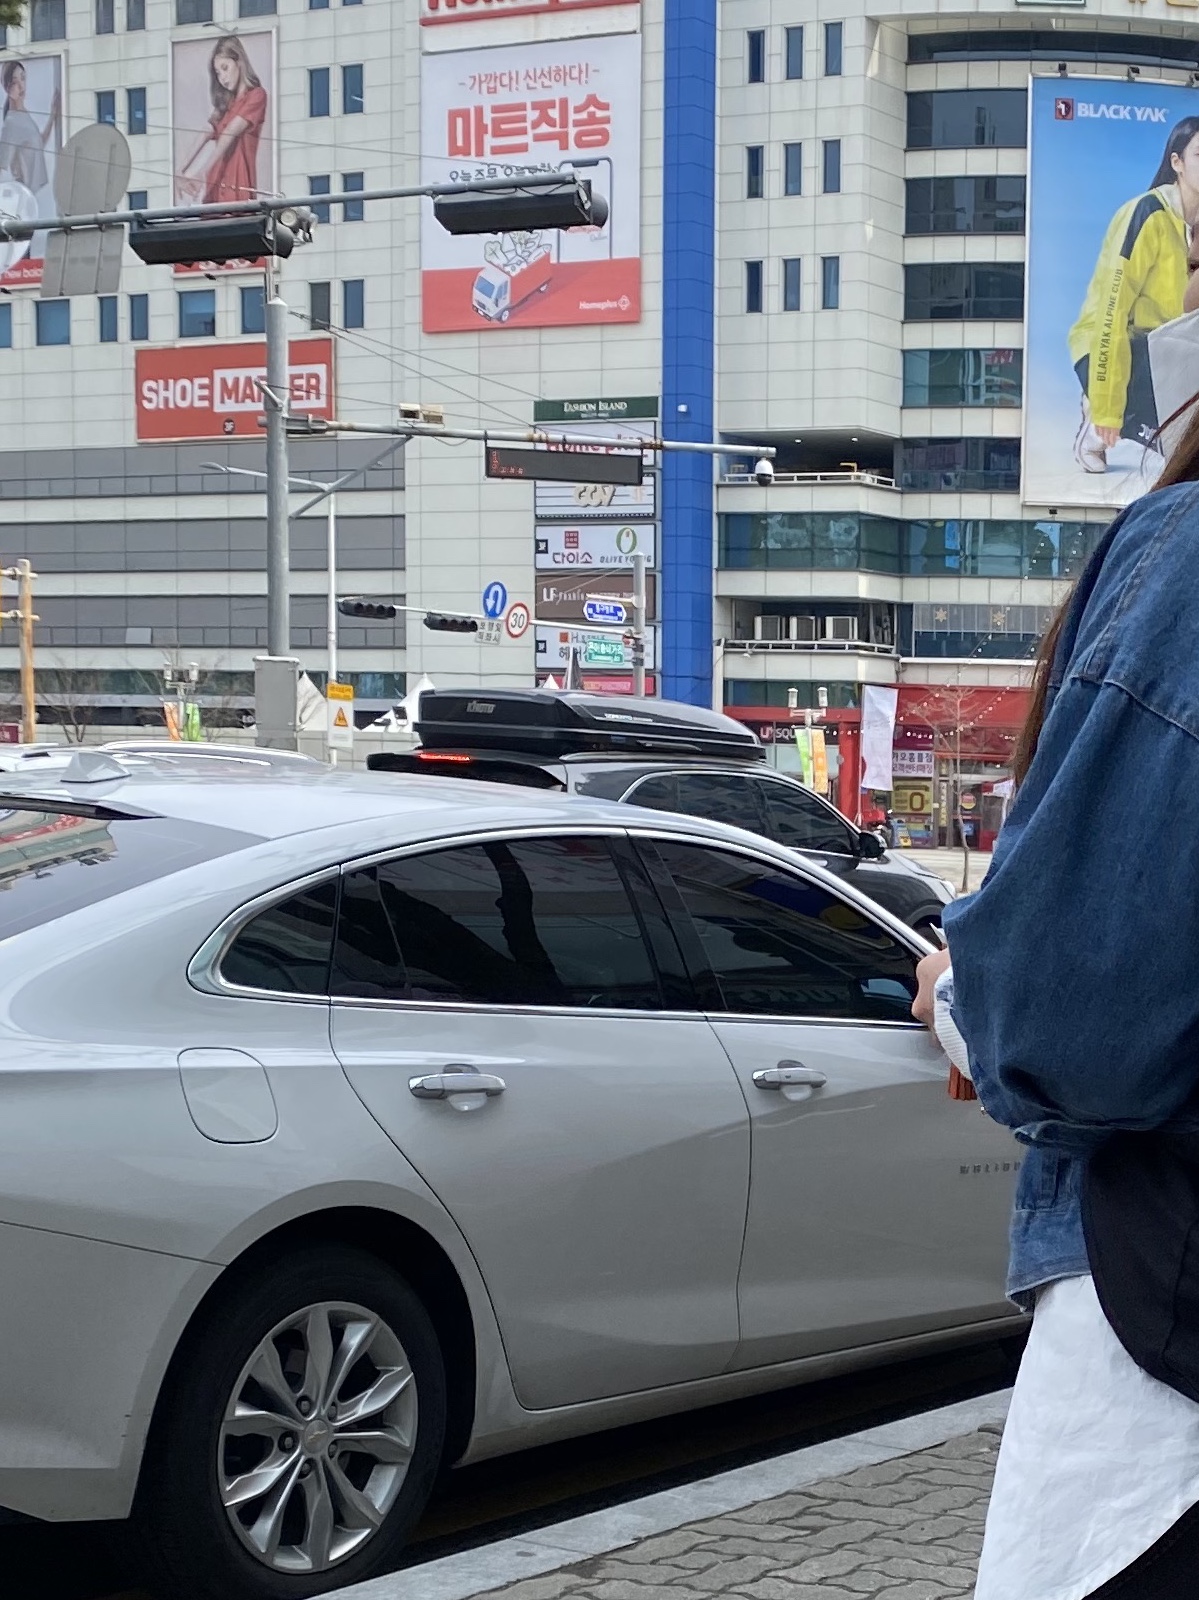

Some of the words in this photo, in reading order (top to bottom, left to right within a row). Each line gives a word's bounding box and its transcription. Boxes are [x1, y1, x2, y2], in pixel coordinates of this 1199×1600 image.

[1076, 102, 1131, 120] BLACK
[1132, 106, 1167, 123] YAK
[446, 92, 612, 158] 마트직송
[1105, 295, 1117, 329] ALPINE
[1112, 268, 1124, 293] CLUB
[142, 376, 210, 410] SHOE
[219, 372, 321, 405] MARER
[598, 401, 628, 411] ISLAND
[552, 551, 593, 564] 다이소
[624, 555, 652, 564] YOG
[510, 612, 525, 629] 30
